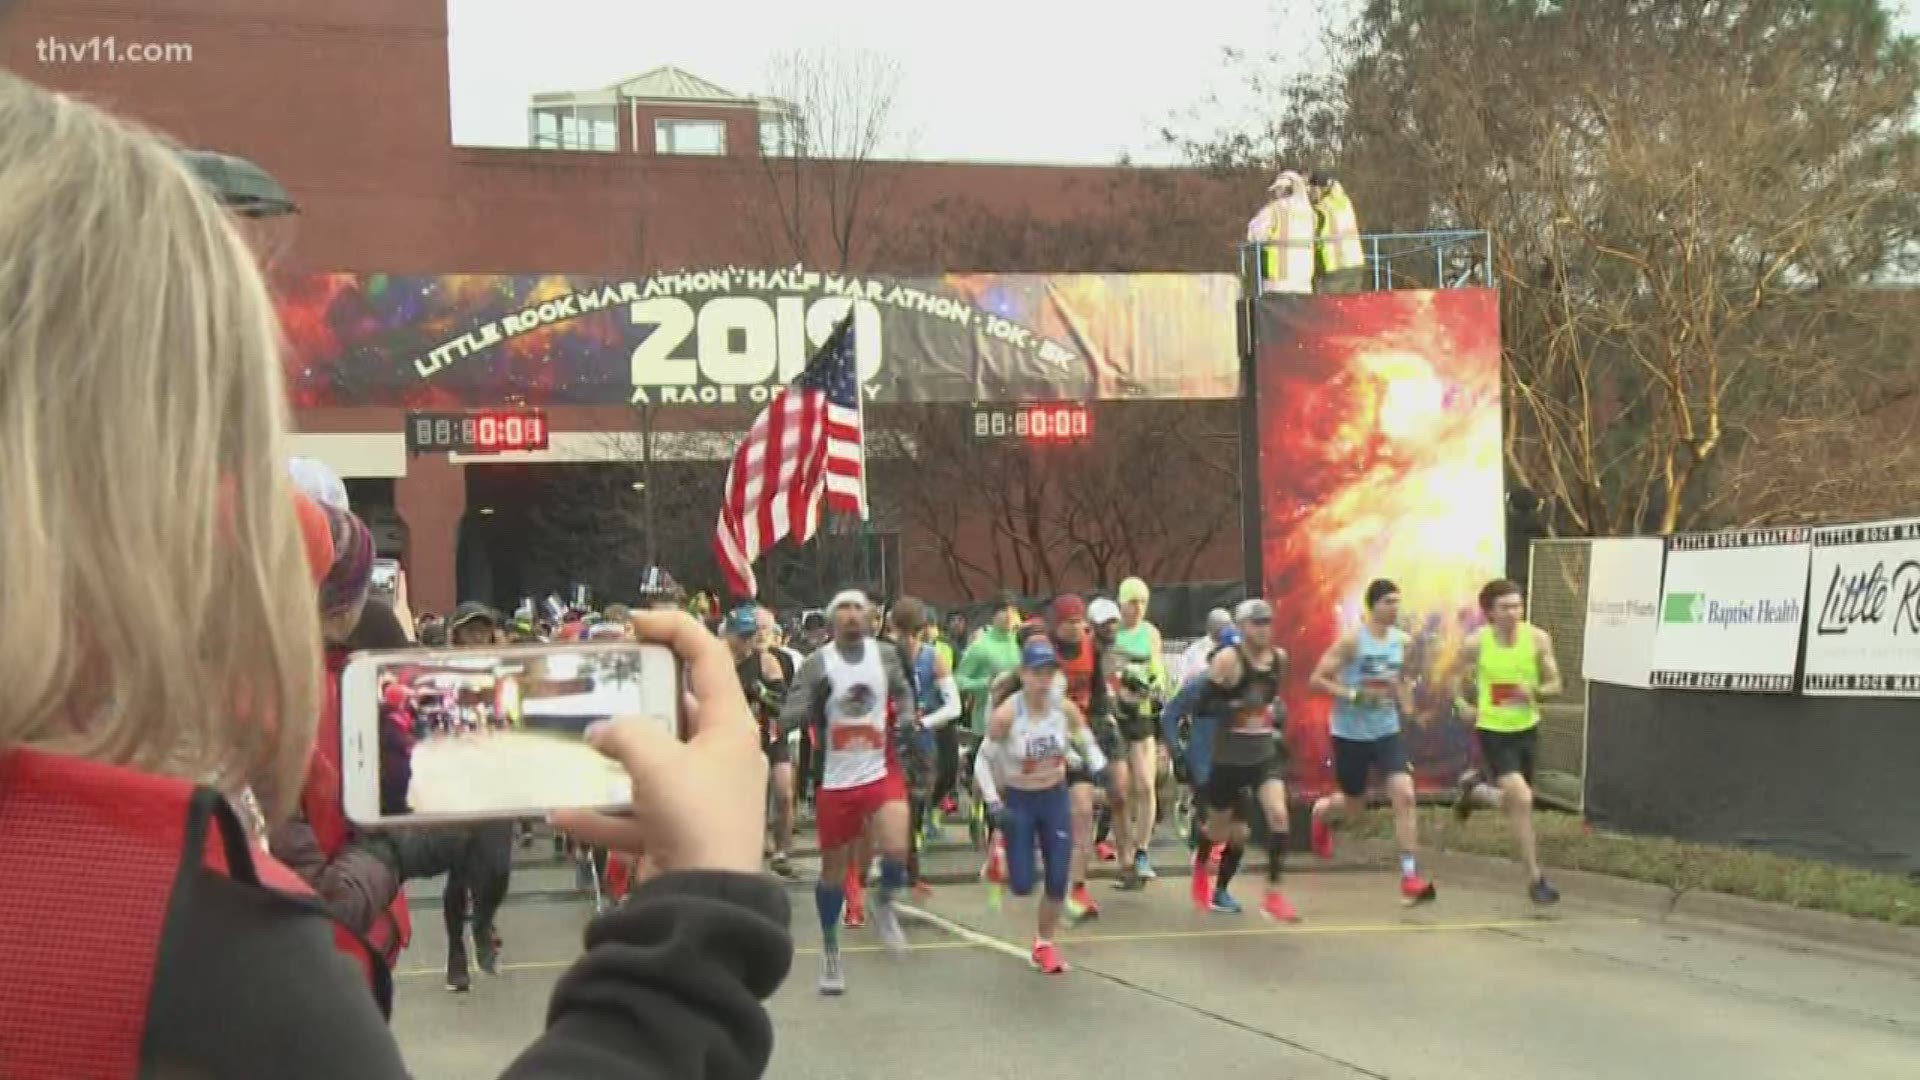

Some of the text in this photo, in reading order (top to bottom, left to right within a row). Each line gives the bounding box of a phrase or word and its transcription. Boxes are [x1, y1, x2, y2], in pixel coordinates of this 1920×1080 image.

[413, 321, 502, 378] LITTLE
[579, 268, 731, 312] MARATHON
[746, 267, 820, 290] HALF
[824, 275, 971, 328] MARATHON
[630, 296, 883, 386] 2019
[630, 385, 650, 403] A
[1707, 598, 1800, 630] Baptist Health
[1817, 561, 1889, 635] Little
